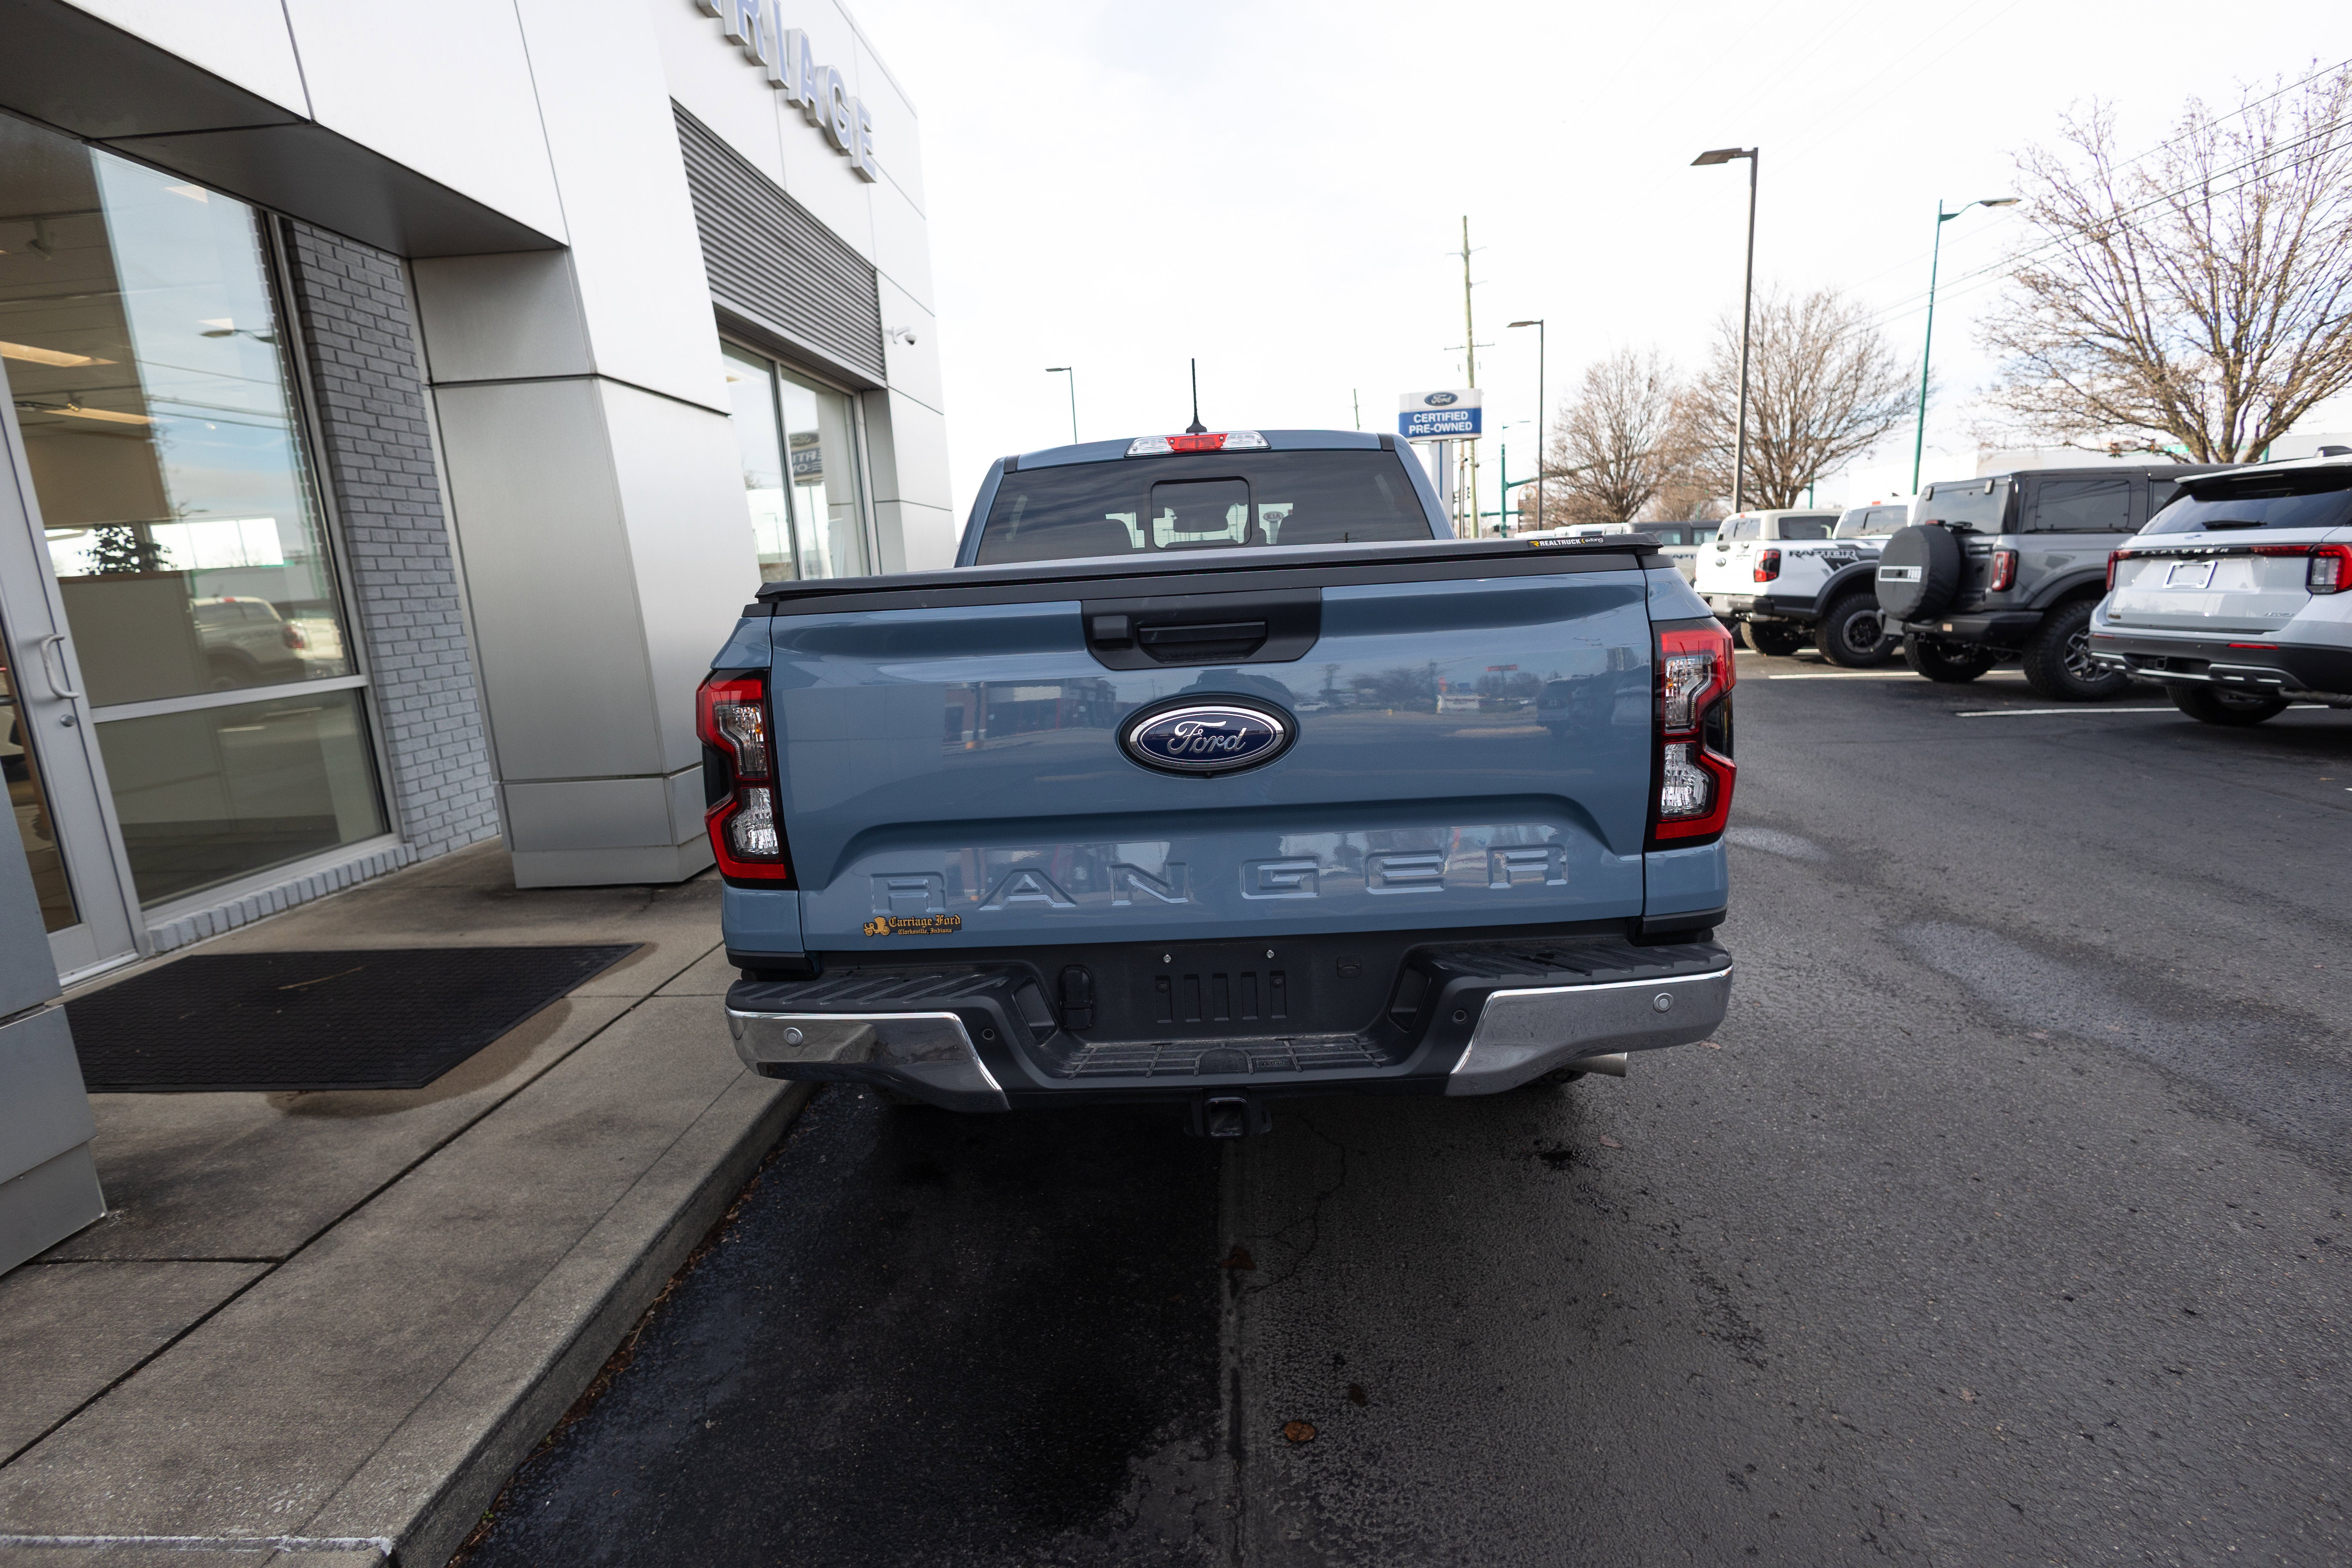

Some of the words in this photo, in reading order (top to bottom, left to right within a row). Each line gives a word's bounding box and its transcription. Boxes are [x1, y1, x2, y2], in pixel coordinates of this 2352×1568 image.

[695, 0, 877, 183] RIAGE
[1431, 394, 1452, 404] Ford
[1413, 411, 1468, 423] CERTIFIED
[1409, 421, 1473, 434] PRE-OWNED
[1788, 548, 1859, 561] RAPTOR
[2141, 547, 2230, 555] EXPLORER
[1167, 720, 1247, 754] Ford
[869, 842, 1568, 914] RANGER
[888, 916, 932, 928] Carriage
[935, 914, 962, 926] Ford
